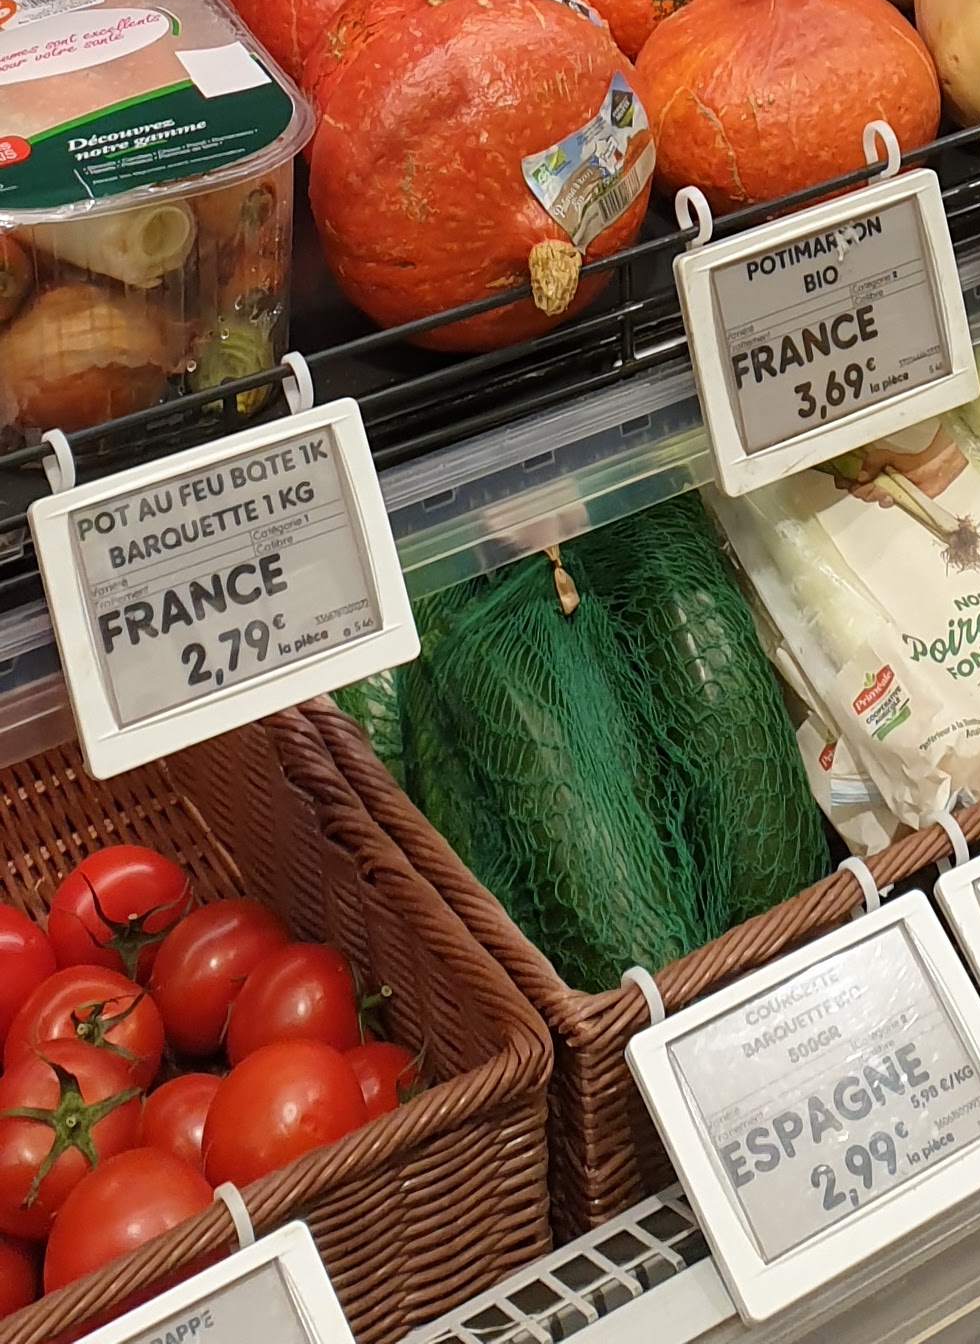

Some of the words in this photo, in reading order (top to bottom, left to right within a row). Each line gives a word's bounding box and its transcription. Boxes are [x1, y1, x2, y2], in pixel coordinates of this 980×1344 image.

[67, 118, 176, 153] Découvrez
[74, 140, 130, 163] notre
[134, 120, 207, 150] gamme
[803, 265, 839, 293] BIO
[731, 304, 879, 390] FRANCE
[882, 370, 910, 392] pièce
[76, 502, 131, 543] POT
[138, 490, 174, 525] AU
[177, 473, 225, 511] FEU
[229, 451, 297, 492] BQTE
[299, 437, 329, 467] 1K
[108, 502, 258, 571] BARQUETTE
[277, 480, 316, 511] KG
[98, 552, 289, 656] FRANCE
[294, 628, 330, 654] pièce
[741, 1002, 832, 1059] BARQUETTE
[719, 1041, 930, 1189] ESPAGNE
[921, 1130, 956, 1161] pièce
